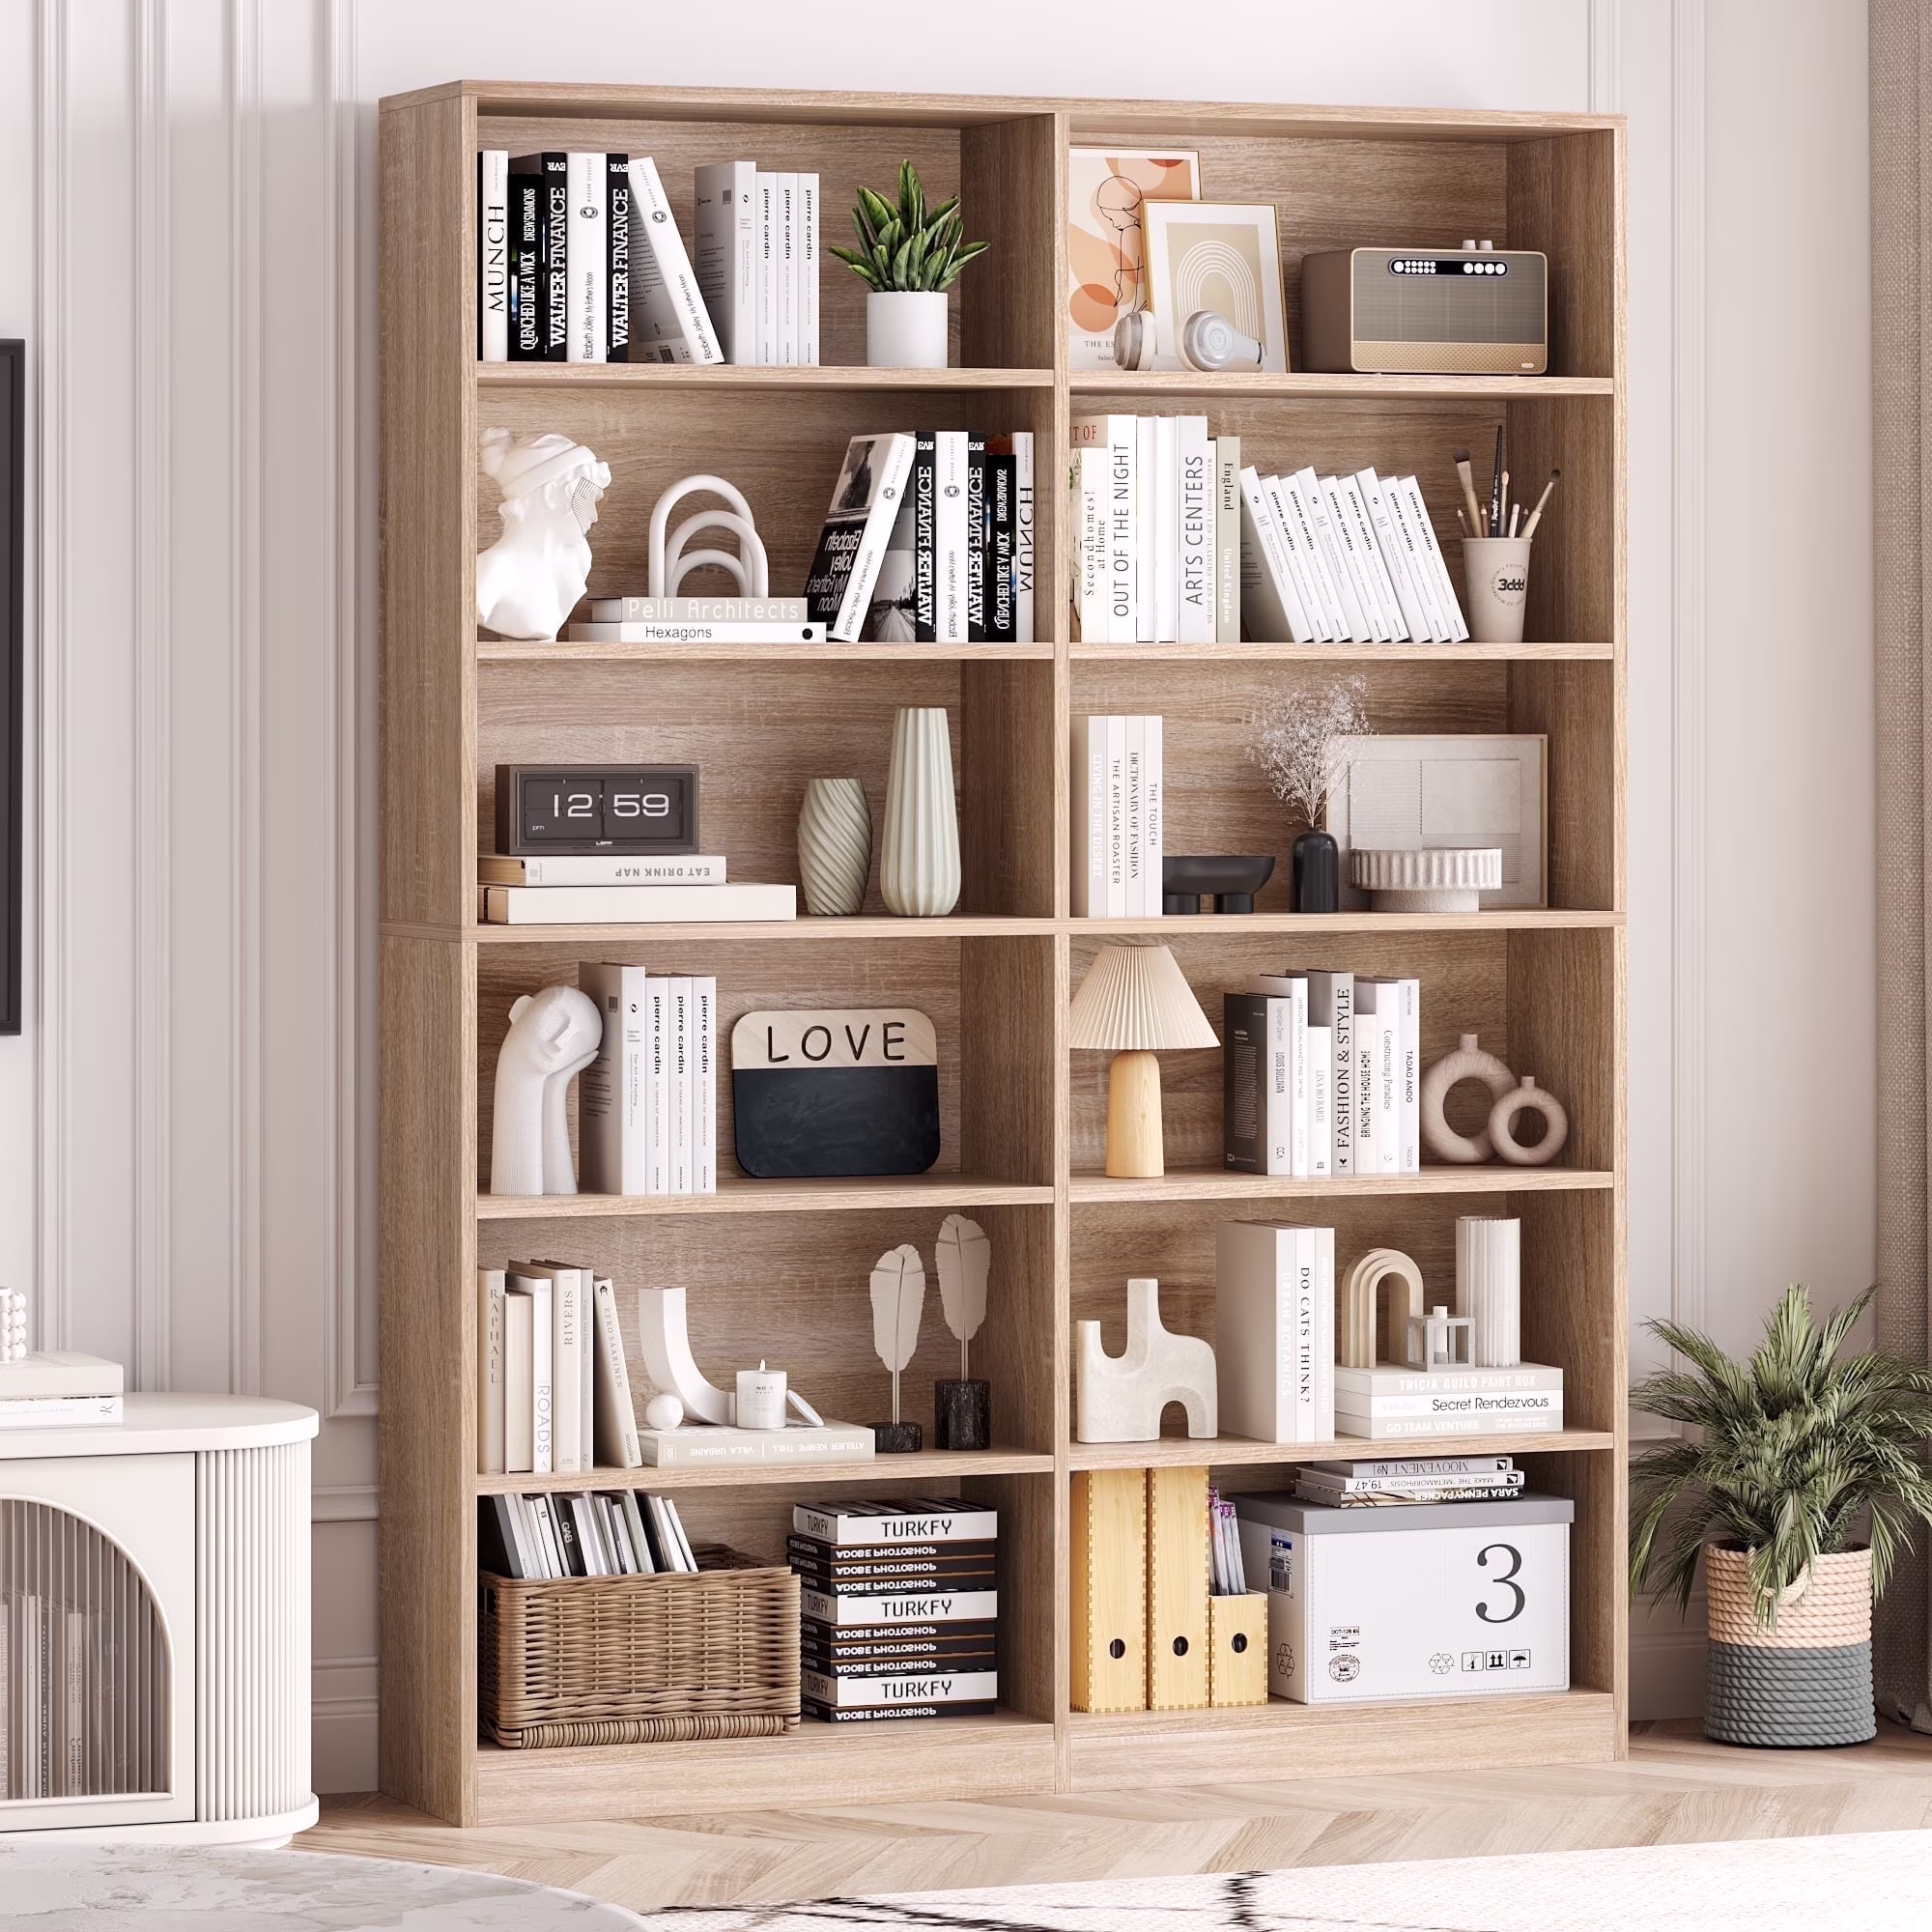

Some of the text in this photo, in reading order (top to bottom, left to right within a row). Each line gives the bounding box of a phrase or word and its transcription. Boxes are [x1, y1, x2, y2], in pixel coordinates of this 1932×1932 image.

[524, 188, 535, 242] DREW SIMMONS
[487, 205, 504, 312] MUNCH
[520, 251, 535, 275] WICK
[550, 187, 565, 347] WALTER FINANCE
[585, 271, 594, 286] Moon
[612, 188, 628, 348] WALTER FINANCE
[520, 285, 535, 302] LIKE
[520, 303, 538, 351] QUENCHED
[583, 315, 595, 332] Jolley
[582, 333, 594, 359] Elizabeth
[1084, 425, 1097, 440] OF
[1221, 463, 1234, 511] England
[1113, 443, 1129, 616] OUT OF THE NIGHT
[1184, 456, 1204, 605] ARTS CENTERS
[1271, 492, 1295, 551] pierre cardin
[1329, 492, 1353, 552] pierre cardin
[1390, 493, 1414, 552] pierre cardin
[1084, 491, 1095, 596] Secondhomes!
[1095, 520, 1105, 570] at Home
[1221, 548, 1232, 623] United Kingdom
[628, 599, 800, 620] Pelli Architects
[645, 625, 712, 641] Hexagons
[1092, 754, 1103, 794] LIVING
[1092, 797, 1103, 809] IN
[1092, 812, 1103, 834] THE
[1129, 753, 1139, 879] DICTIONARY OF FASHION
[614, 867, 710, 877] EAT DRINK NAP
[767, 1022, 905, 1062] LOVE
[1275, 1052, 1285, 1067] LOUIS
[1381, 1030, 1393, 1077] Constructing
[1275, 1068, 1285, 1094] SULLIVAN
[1316, 1070, 1324, 1088] LINA
[1337, 989, 1350, 1148] FASHION & STYLE
[1316, 1089, 1324, 1099] BO
[1360, 1050, 1371, 1138] BRINGING THE HOUSE HOME
[1276, 1147, 1285, 1159] CCA
[490, 1289, 499, 1383] RAPHAEL
[563, 1291, 573, 1346] RIVERS
[1282, 1272, 1291, 1397] URBAN BOTANICS
[1300, 1267, 1310, 1403] DO CATS THINK?
[604, 1307, 623, 1388] EERO SAARINEN
[1399, 1375, 1536, 1392] TRICIA GUILD PAINT BOX
[537, 1384, 551, 1453] ROADS
[1432, 1398, 1471, 1411] Secret
[1475, 1397, 1549, 1409] Rendezvous
[831, 1441, 865, 1451] ATELIER
[1386, 1420, 1480, 1434] GO TEAM VENTURE
[690, 1445, 753, 1457] VILLA URBAINE
[798, 1443, 827, 1453] KEMPE
[1393, 1461, 1468, 1475] MOOVEMENT
[1414, 1488, 1519, 1500] SARA PENNYPACKER
[1475, 1544, 1526, 1623] 3
